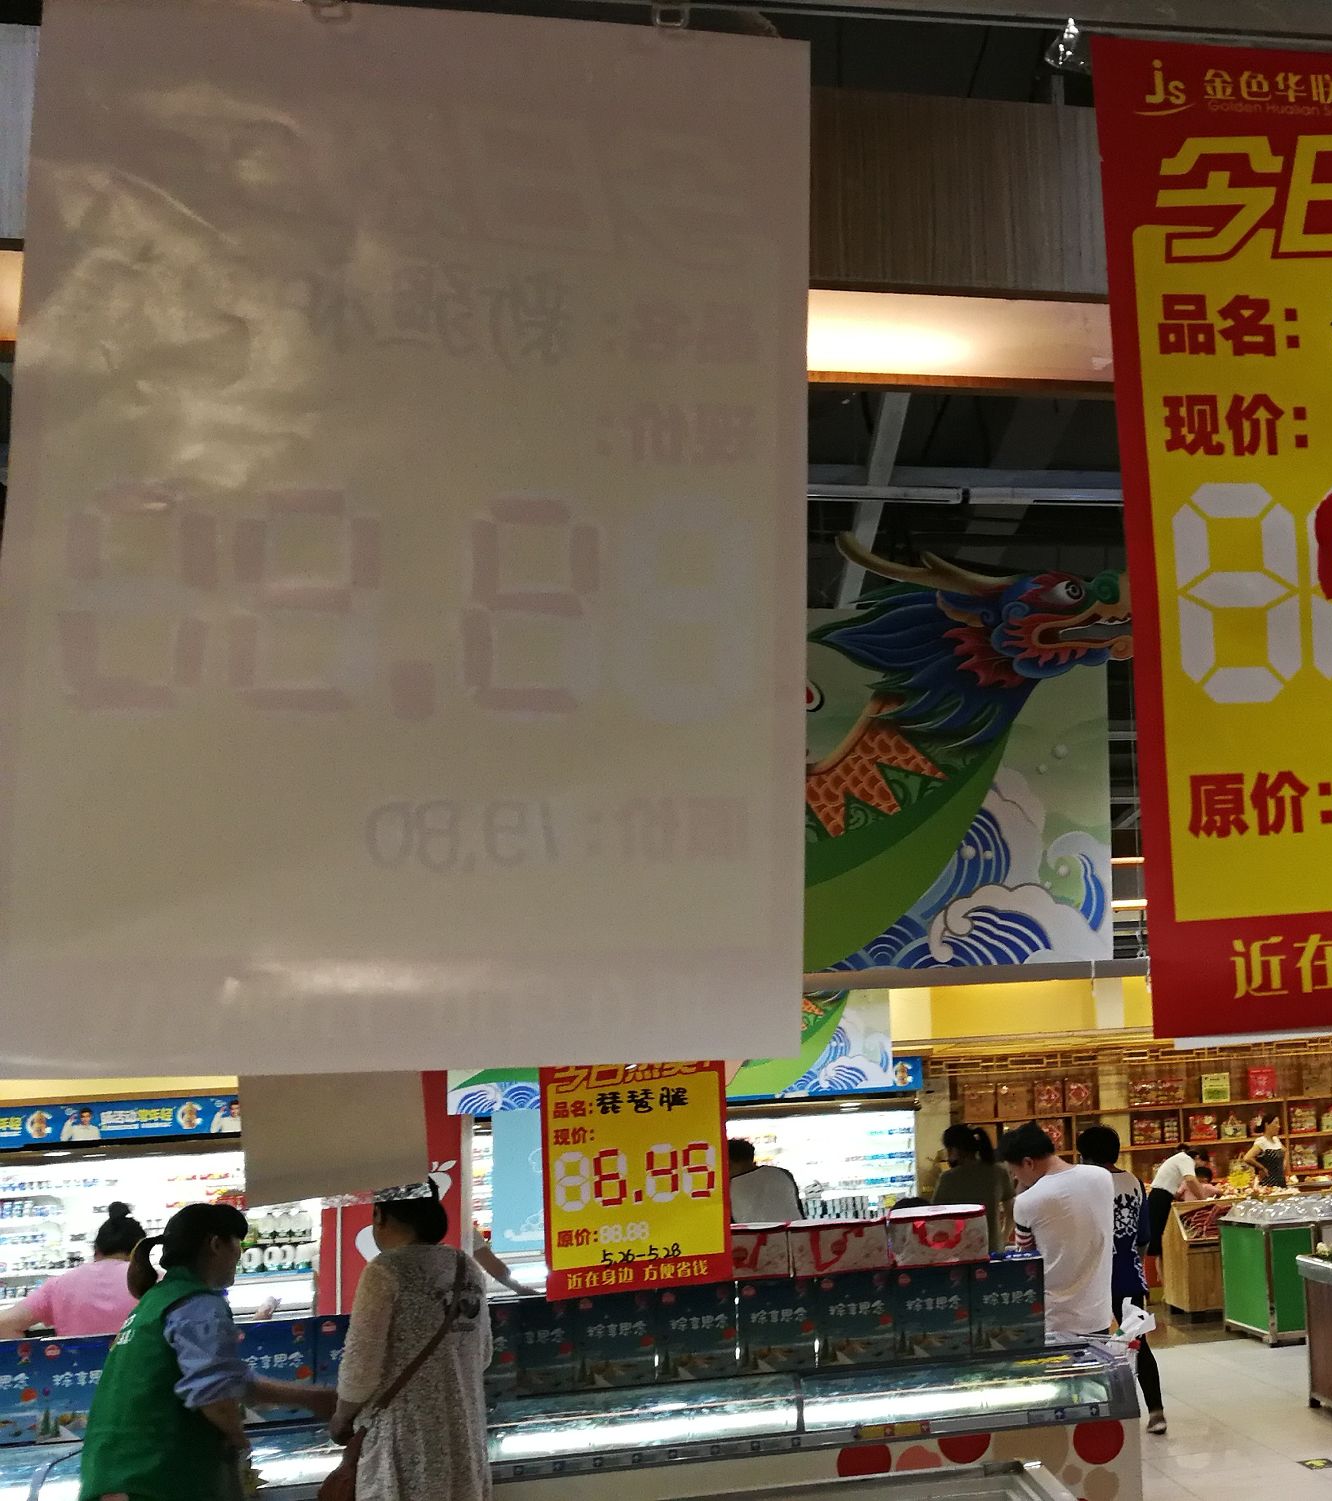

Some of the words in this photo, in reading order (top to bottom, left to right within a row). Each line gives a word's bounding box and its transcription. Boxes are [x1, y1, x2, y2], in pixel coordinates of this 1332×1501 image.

[1207, 101, 1263, 114] Golden
[1157, 294, 1301, 357] 品名：
[1162, 393, 1310, 456] 现价：
[552, 1100, 594, 1120] 品名：
[552, 1126, 596, 1146] 现价：
[556, 1229, 599, 1248] 原价：
[566, 1267, 634, 1291] 近在身边
[642, 1259, 709, 1283] 方便省钱
